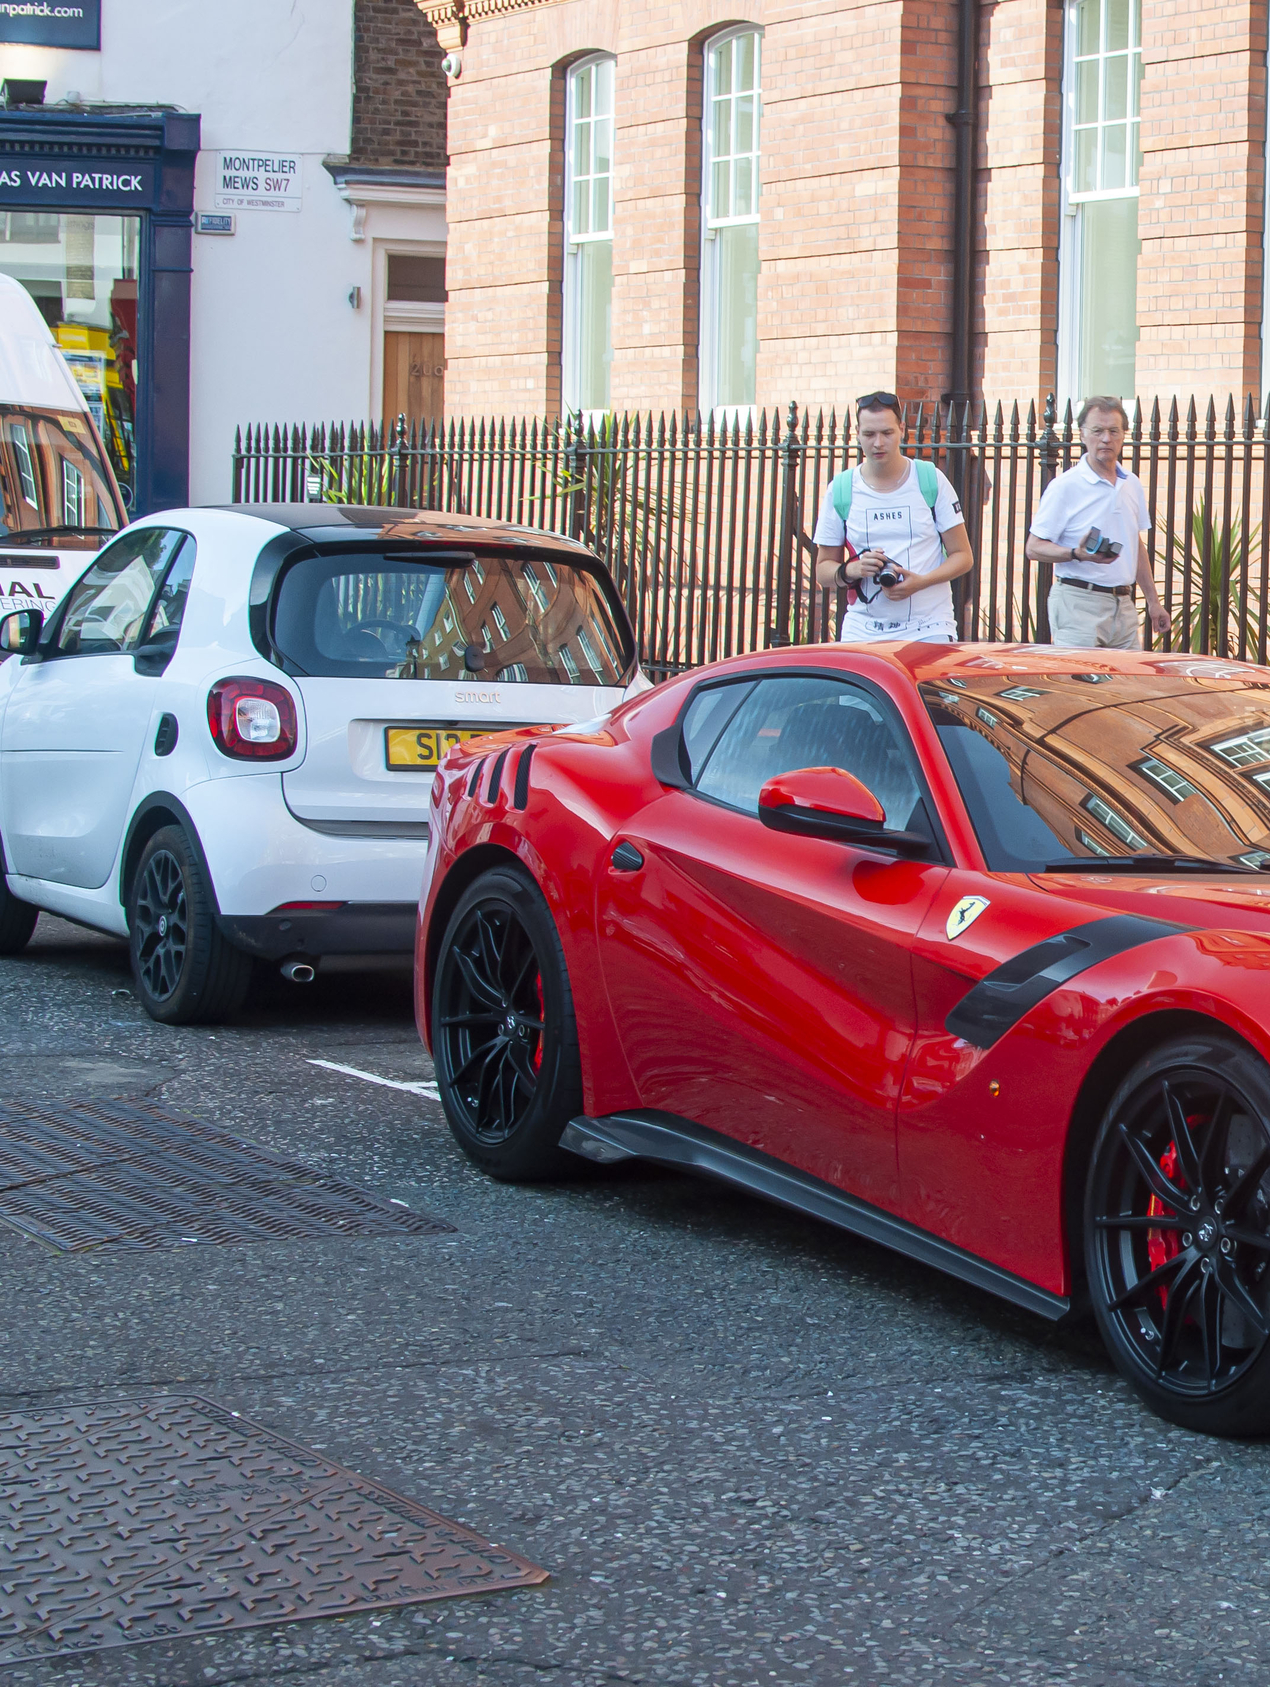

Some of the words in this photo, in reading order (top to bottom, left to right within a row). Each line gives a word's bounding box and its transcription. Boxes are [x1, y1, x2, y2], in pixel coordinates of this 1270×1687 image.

[0, 2, 83, 17] npatrick.com
[223, 156, 296, 174] MONTPELIER
[27, 171, 66, 187] VAN
[72, 172, 142, 191] PATRICK
[222, 175, 259, 191] MEWS
[264, 177, 290, 192] SW7
[247, 199, 285, 208] WESTMINSTER
[874, 511, 902, 520] ASHES
[455, 690, 501, 703] smart
